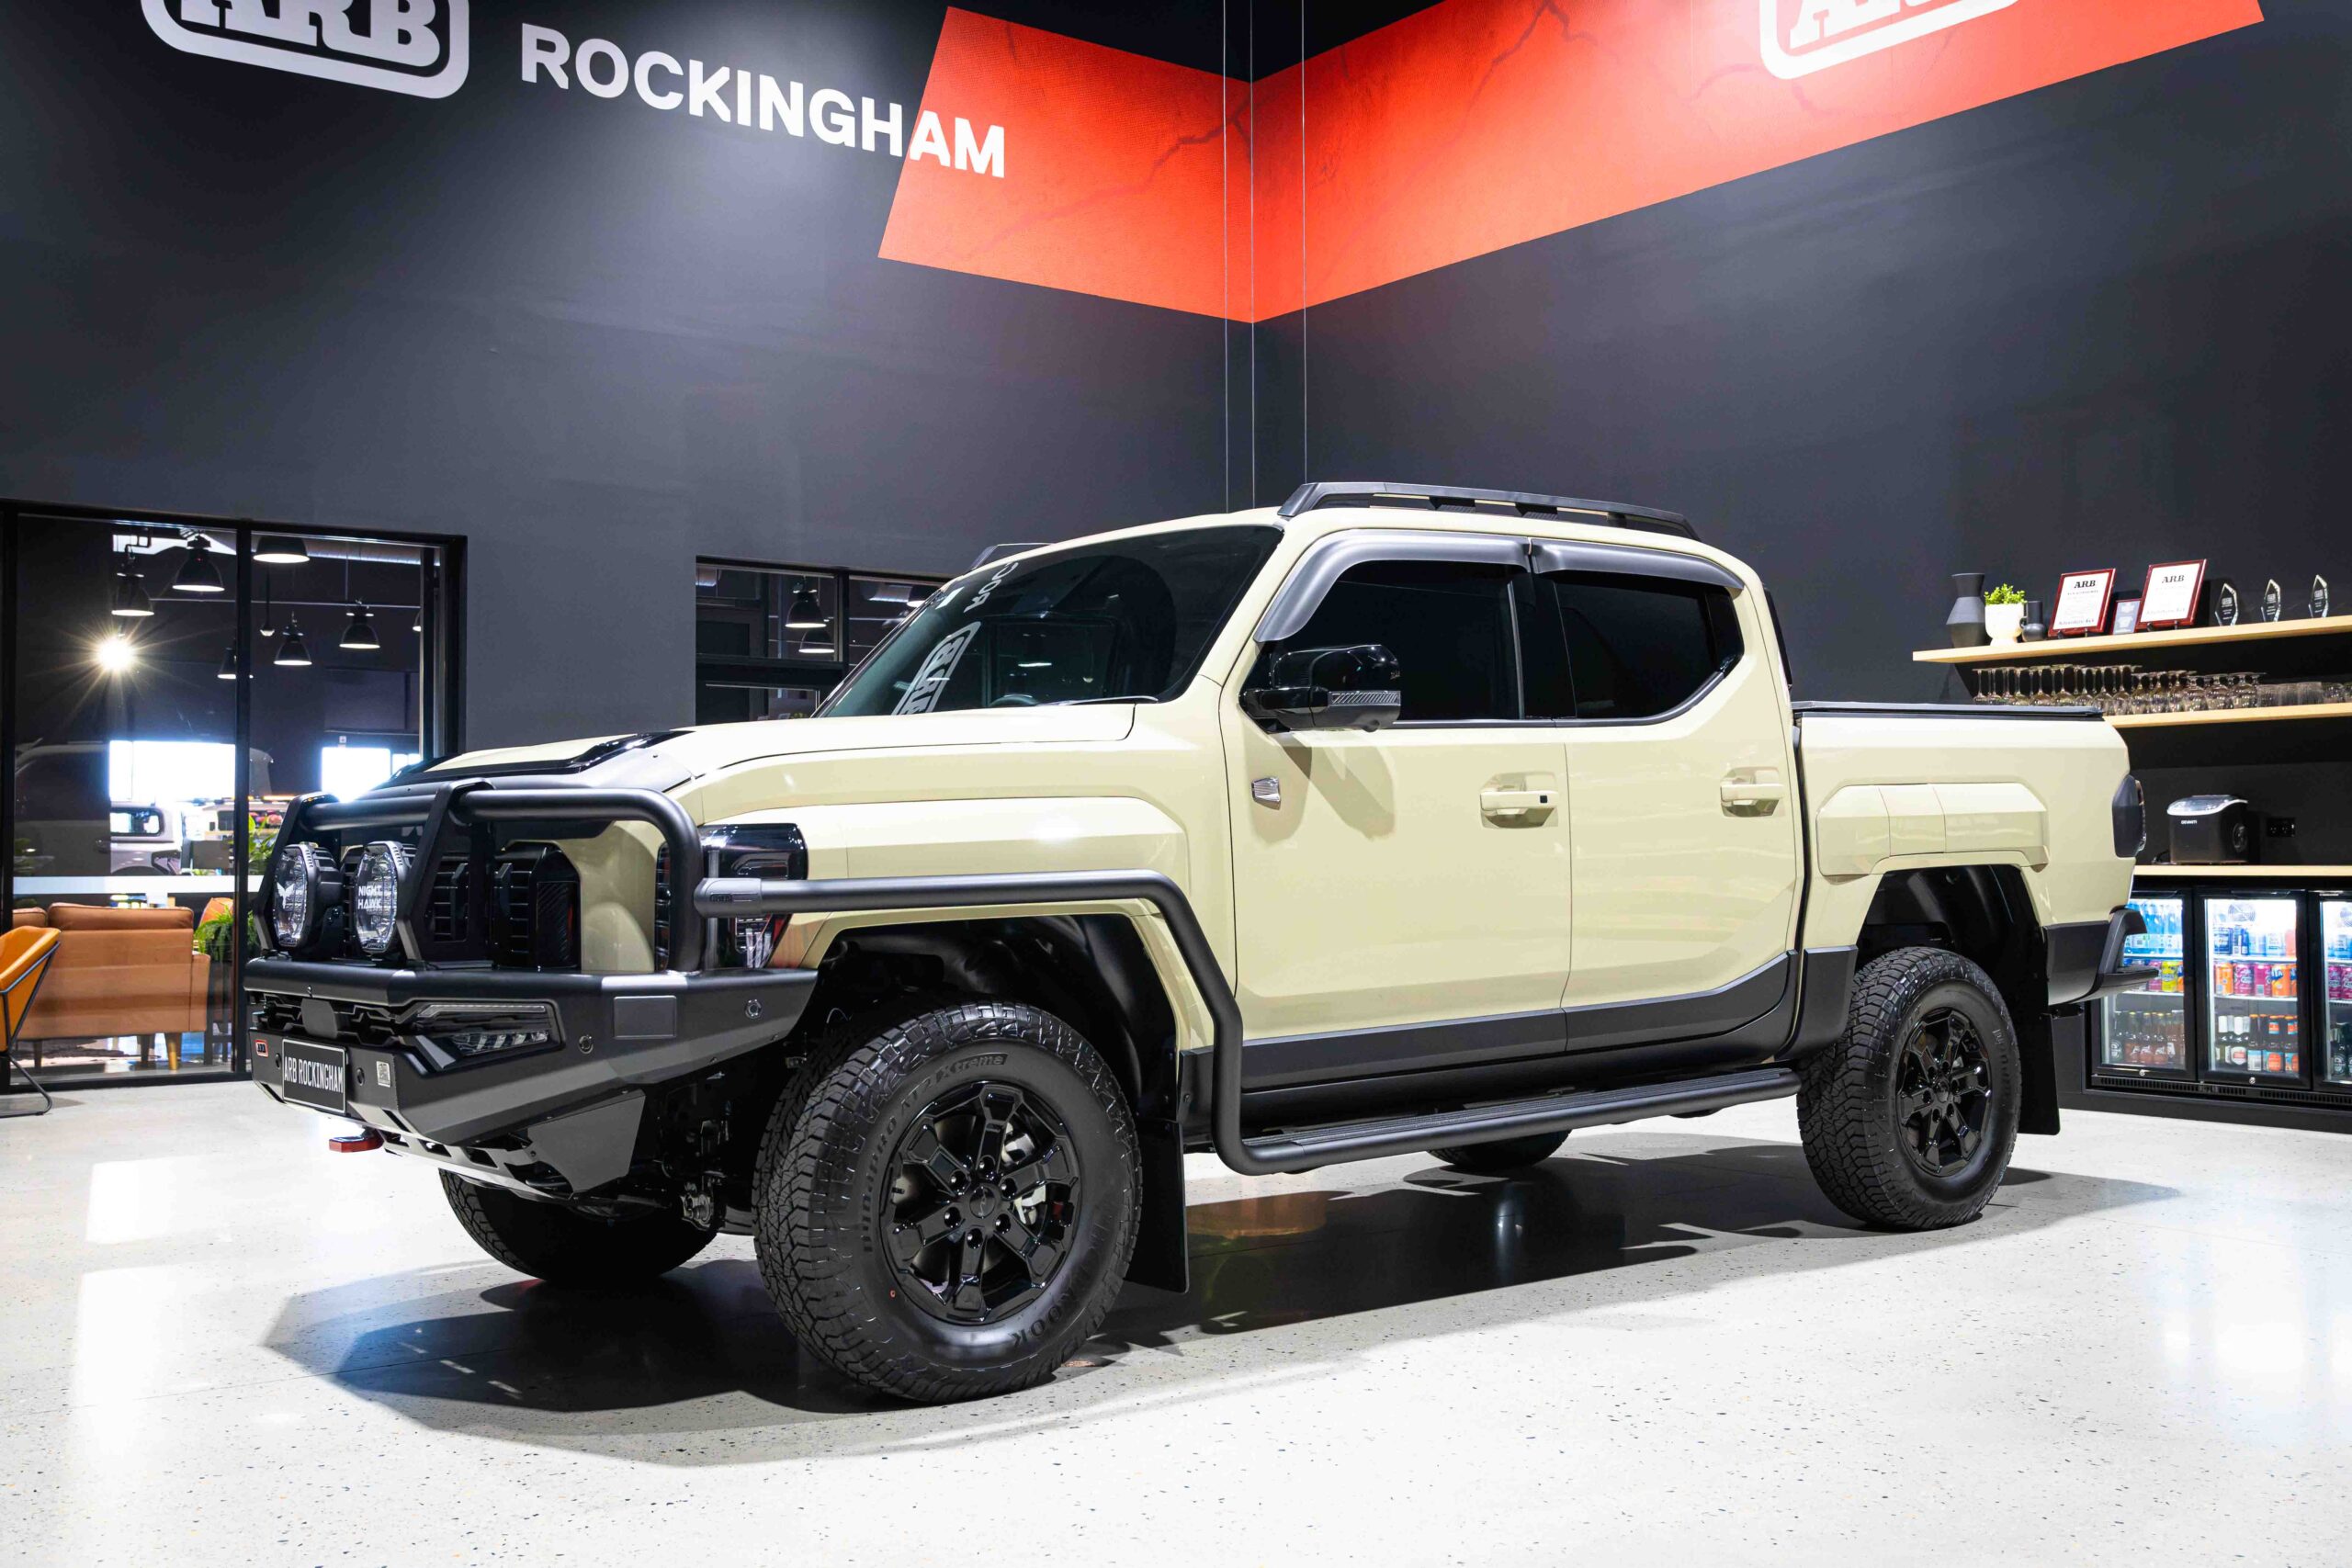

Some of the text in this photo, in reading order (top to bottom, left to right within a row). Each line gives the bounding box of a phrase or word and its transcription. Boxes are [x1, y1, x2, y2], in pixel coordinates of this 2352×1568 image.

[521, 22, 1005, 178] ROCKINGHAM
[2074, 580, 2097, 589] ARB
[2162, 574, 2185, 584] ARB
[358, 885, 383, 897] NIGHT
[357, 898, 383, 909] HAWK
[284, 1055, 344, 1094] ARB ROCKINGHAM
